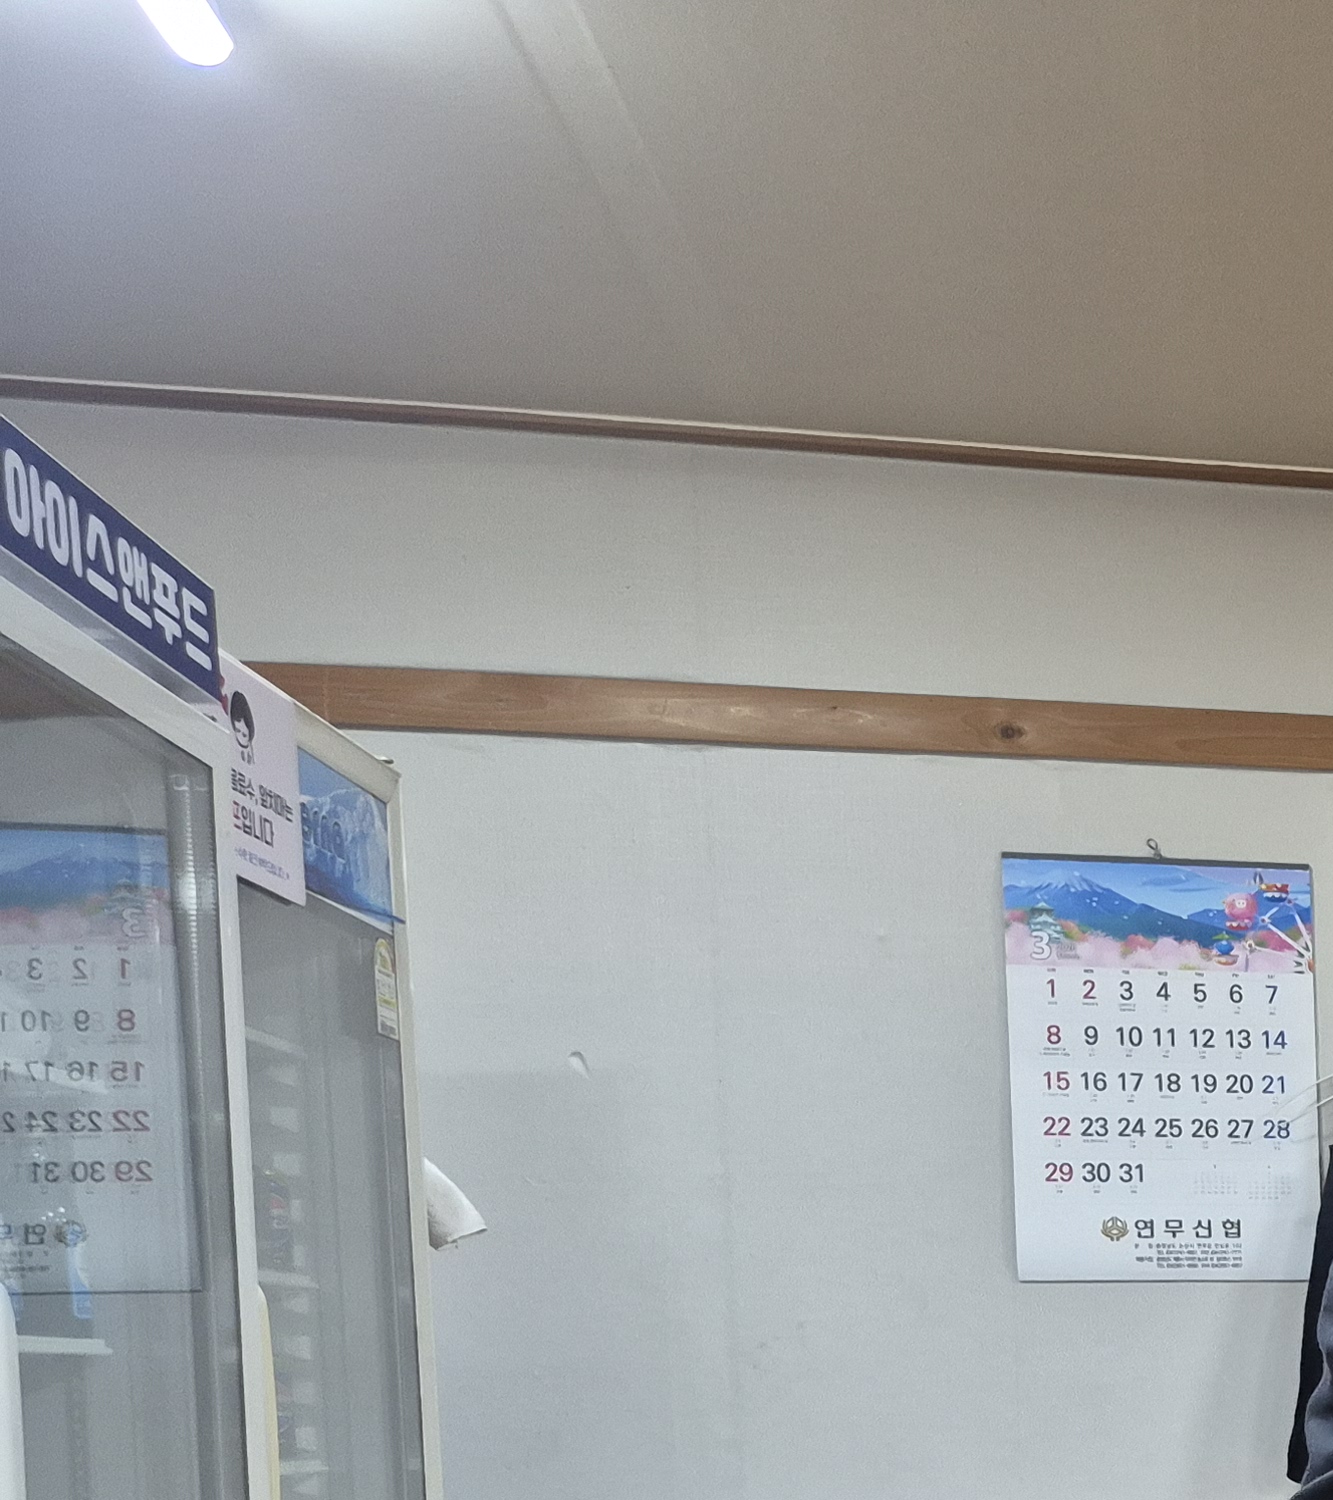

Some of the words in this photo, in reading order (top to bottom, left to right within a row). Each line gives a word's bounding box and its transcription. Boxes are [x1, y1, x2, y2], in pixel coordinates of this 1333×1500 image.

[4, 447, 213, 671] 아이스앤푸드
[1030, 930, 1052, 960] 3
[1047, 979, 1055, 998] 1
[1083, 980, 1097, 999] 2
[1120, 981, 1133, 1001] 3
[1156, 982, 1171, 1001] 4
[1194, 983, 1207, 1003] 5
[1229, 984, 1243, 1003] 6
[1265, 985, 1278, 1004] 7
[1047, 1025, 1061, 1045] 8
[1084, 1026, 1098, 1045] 9
[1116, 1026, 1143, 1047] 10
[1153, 1027, 1175, 1047] 11
[1189, 1028, 1215, 1048] 12
[1225, 1029, 1251, 1049] 13
[1262, 1030, 1288, 1049] 14
[1043, 1071, 1070, 1090] 15
[1081, 1072, 1107, 1091] 16
[1118, 1072, 1143, 1092] 17
[1154, 1073, 1181, 1092] 18
[1191, 1074, 1217, 1093] 19
[1226, 1074, 1253, 1094] 20
[1262, 1075, 1285, 1094] 21
[1043, 1116, 1071, 1136] 22
[1080, 1117, 1109, 1137] 23
[1118, 1117, 1146, 1137] 24
[1154, 1118, 1182, 1138] 25
[1191, 1118, 1219, 1138] 26
[1227, 1119, 1254, 1139] 27
[1263, 1119, 1292, 1139] 28
[1045, 1162, 1073, 1182] 29
[1082, 1162, 1111, 1183] 30
[1119, 1163, 1143, 1183] 31
[1134, 1218, 1241, 1239] 연무신협
